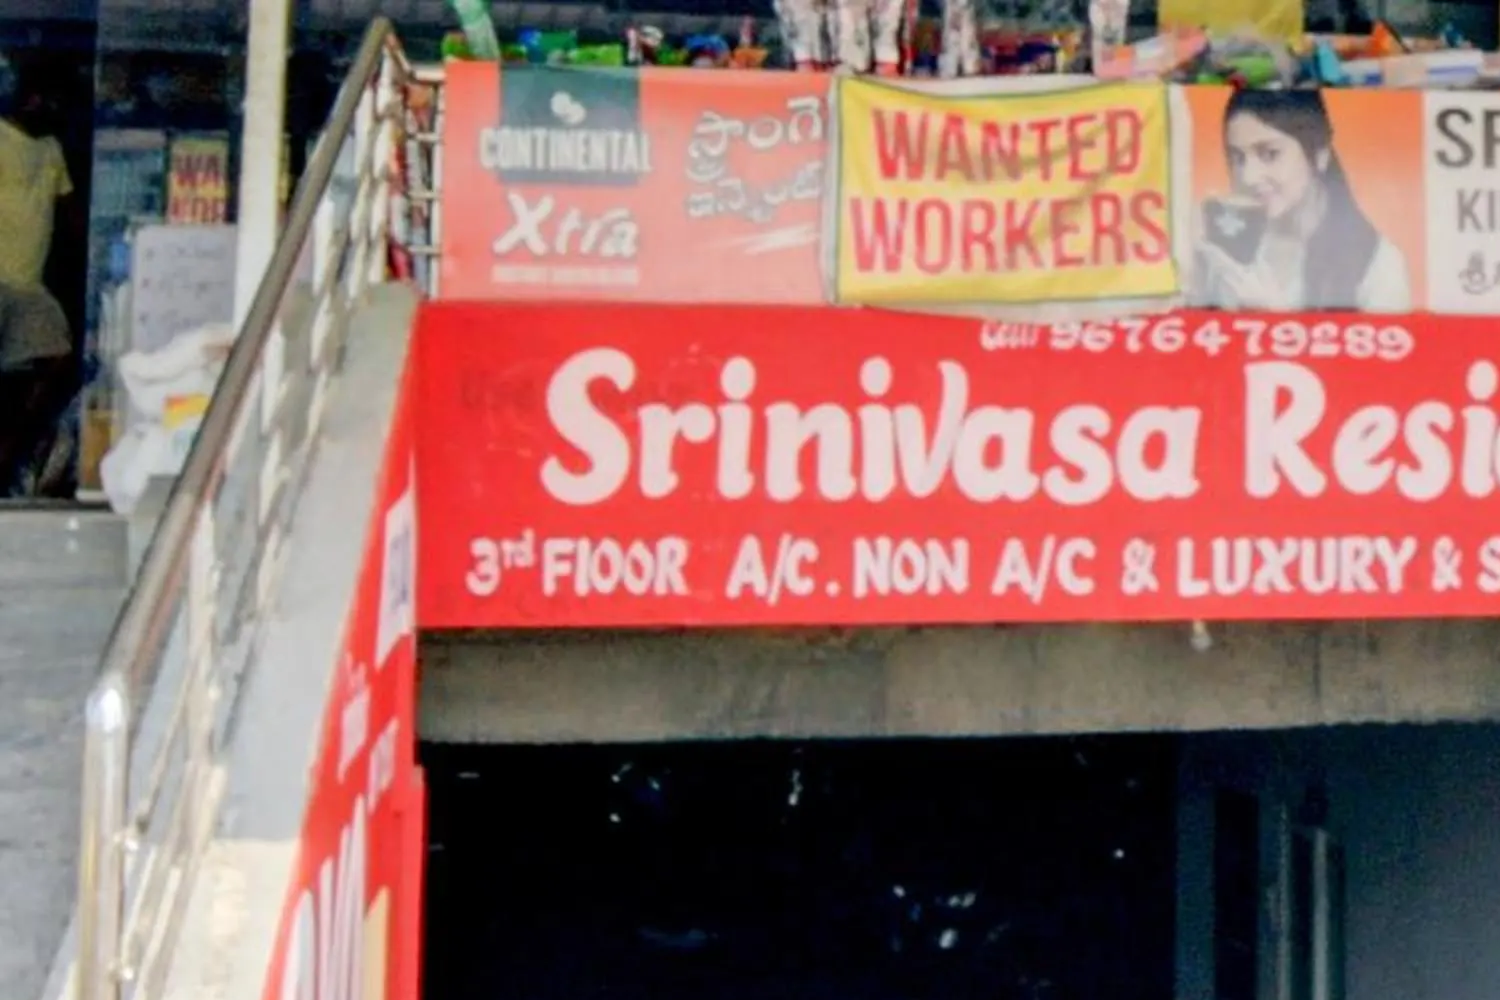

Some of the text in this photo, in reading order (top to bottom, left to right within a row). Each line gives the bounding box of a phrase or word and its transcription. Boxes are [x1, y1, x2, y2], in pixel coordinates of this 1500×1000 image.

[478, 127, 653, 173] CONTINENTAL
[871, 106, 1143, 181] WANTED
[492, 189, 639, 258] Xtra
[849, 190, 1170, 276] WORKERS
[540, 348, 1201, 505] Srinivasa
[466, 528, 535, 597] 3rd
[852, 535, 970, 599] NON
[991, 534, 1096, 605] A/C
[1120, 537, 1160, 597] &
[1176, 535, 1417, 599] LUXURY
[1430, 535, 1463, 594] &
